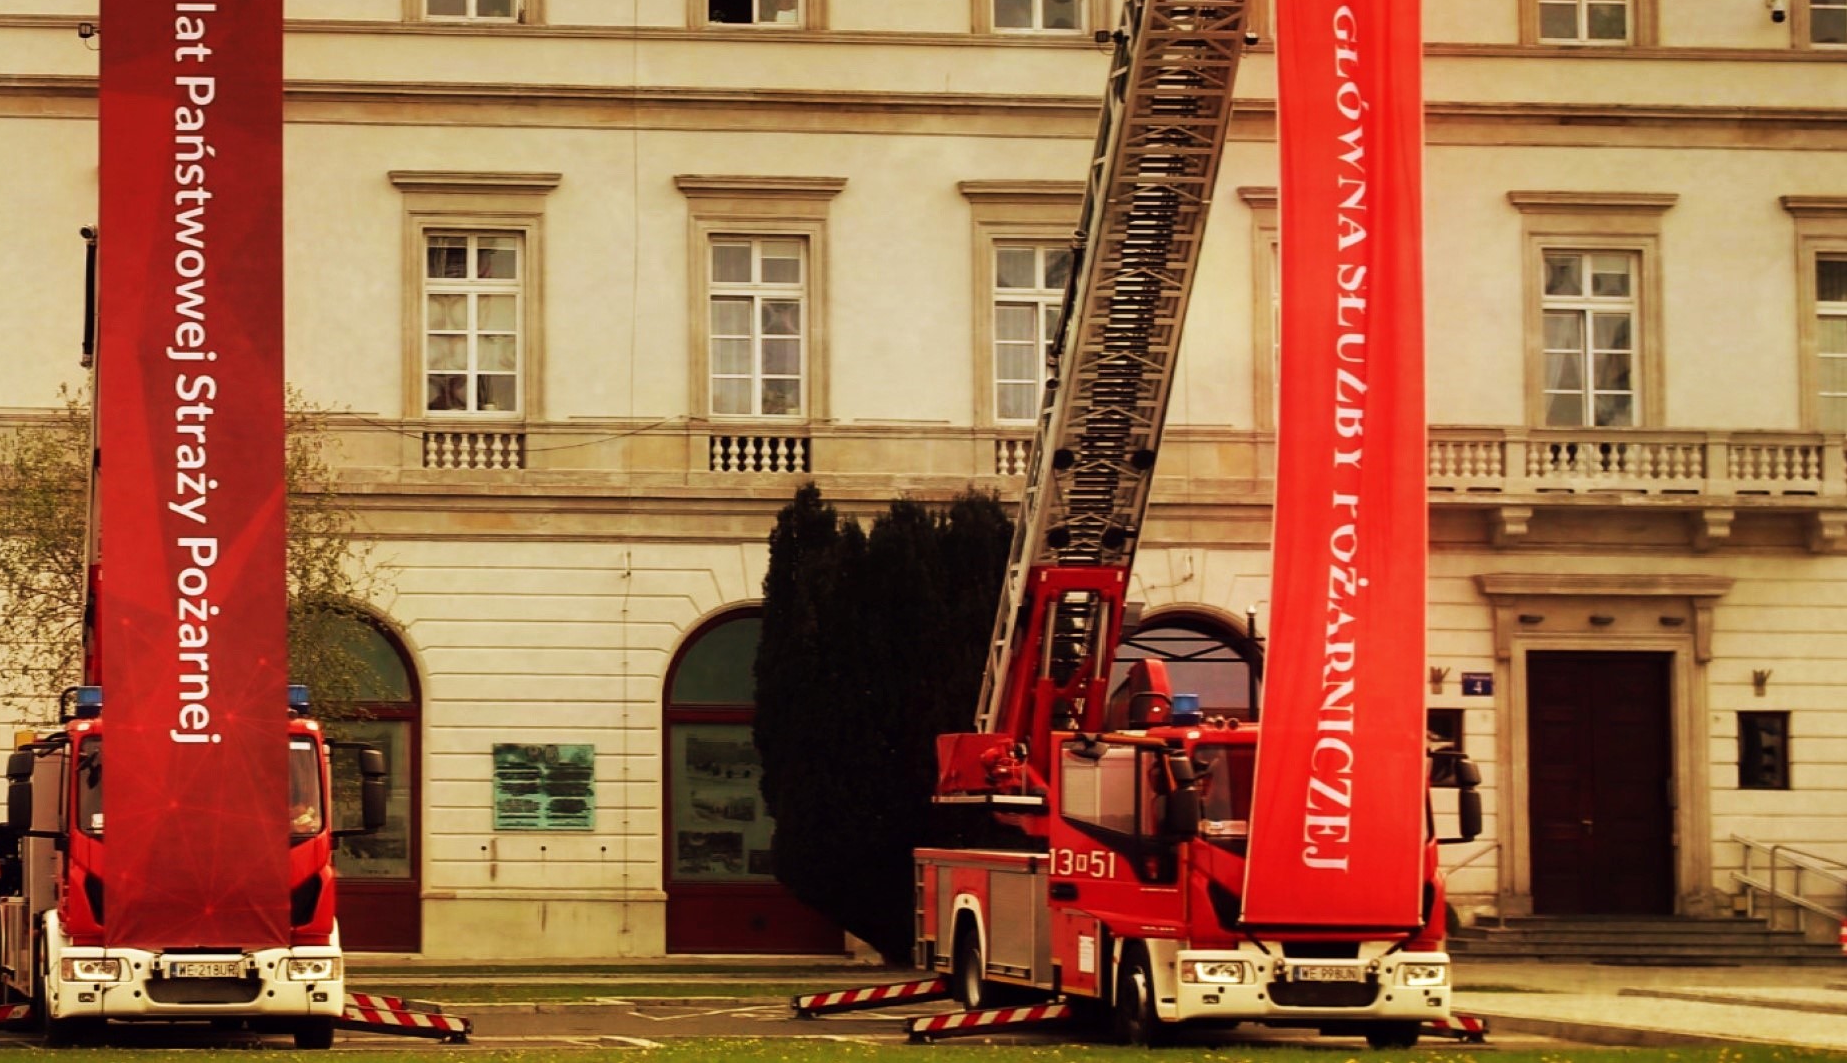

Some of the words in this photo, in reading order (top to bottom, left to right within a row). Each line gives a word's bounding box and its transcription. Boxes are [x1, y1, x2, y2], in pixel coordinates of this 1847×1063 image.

[174, 3, 217, 63] lat
[1332, 5, 1369, 252] GŁÓWNA
[166, 76, 217, 362] Państwowej
[168, 374, 219, 524] Straży
[169, 537, 222, 744] Pożarnej
[1473, 681, 1482, 694] 4
[1090, 850, 1115, 878] 51
